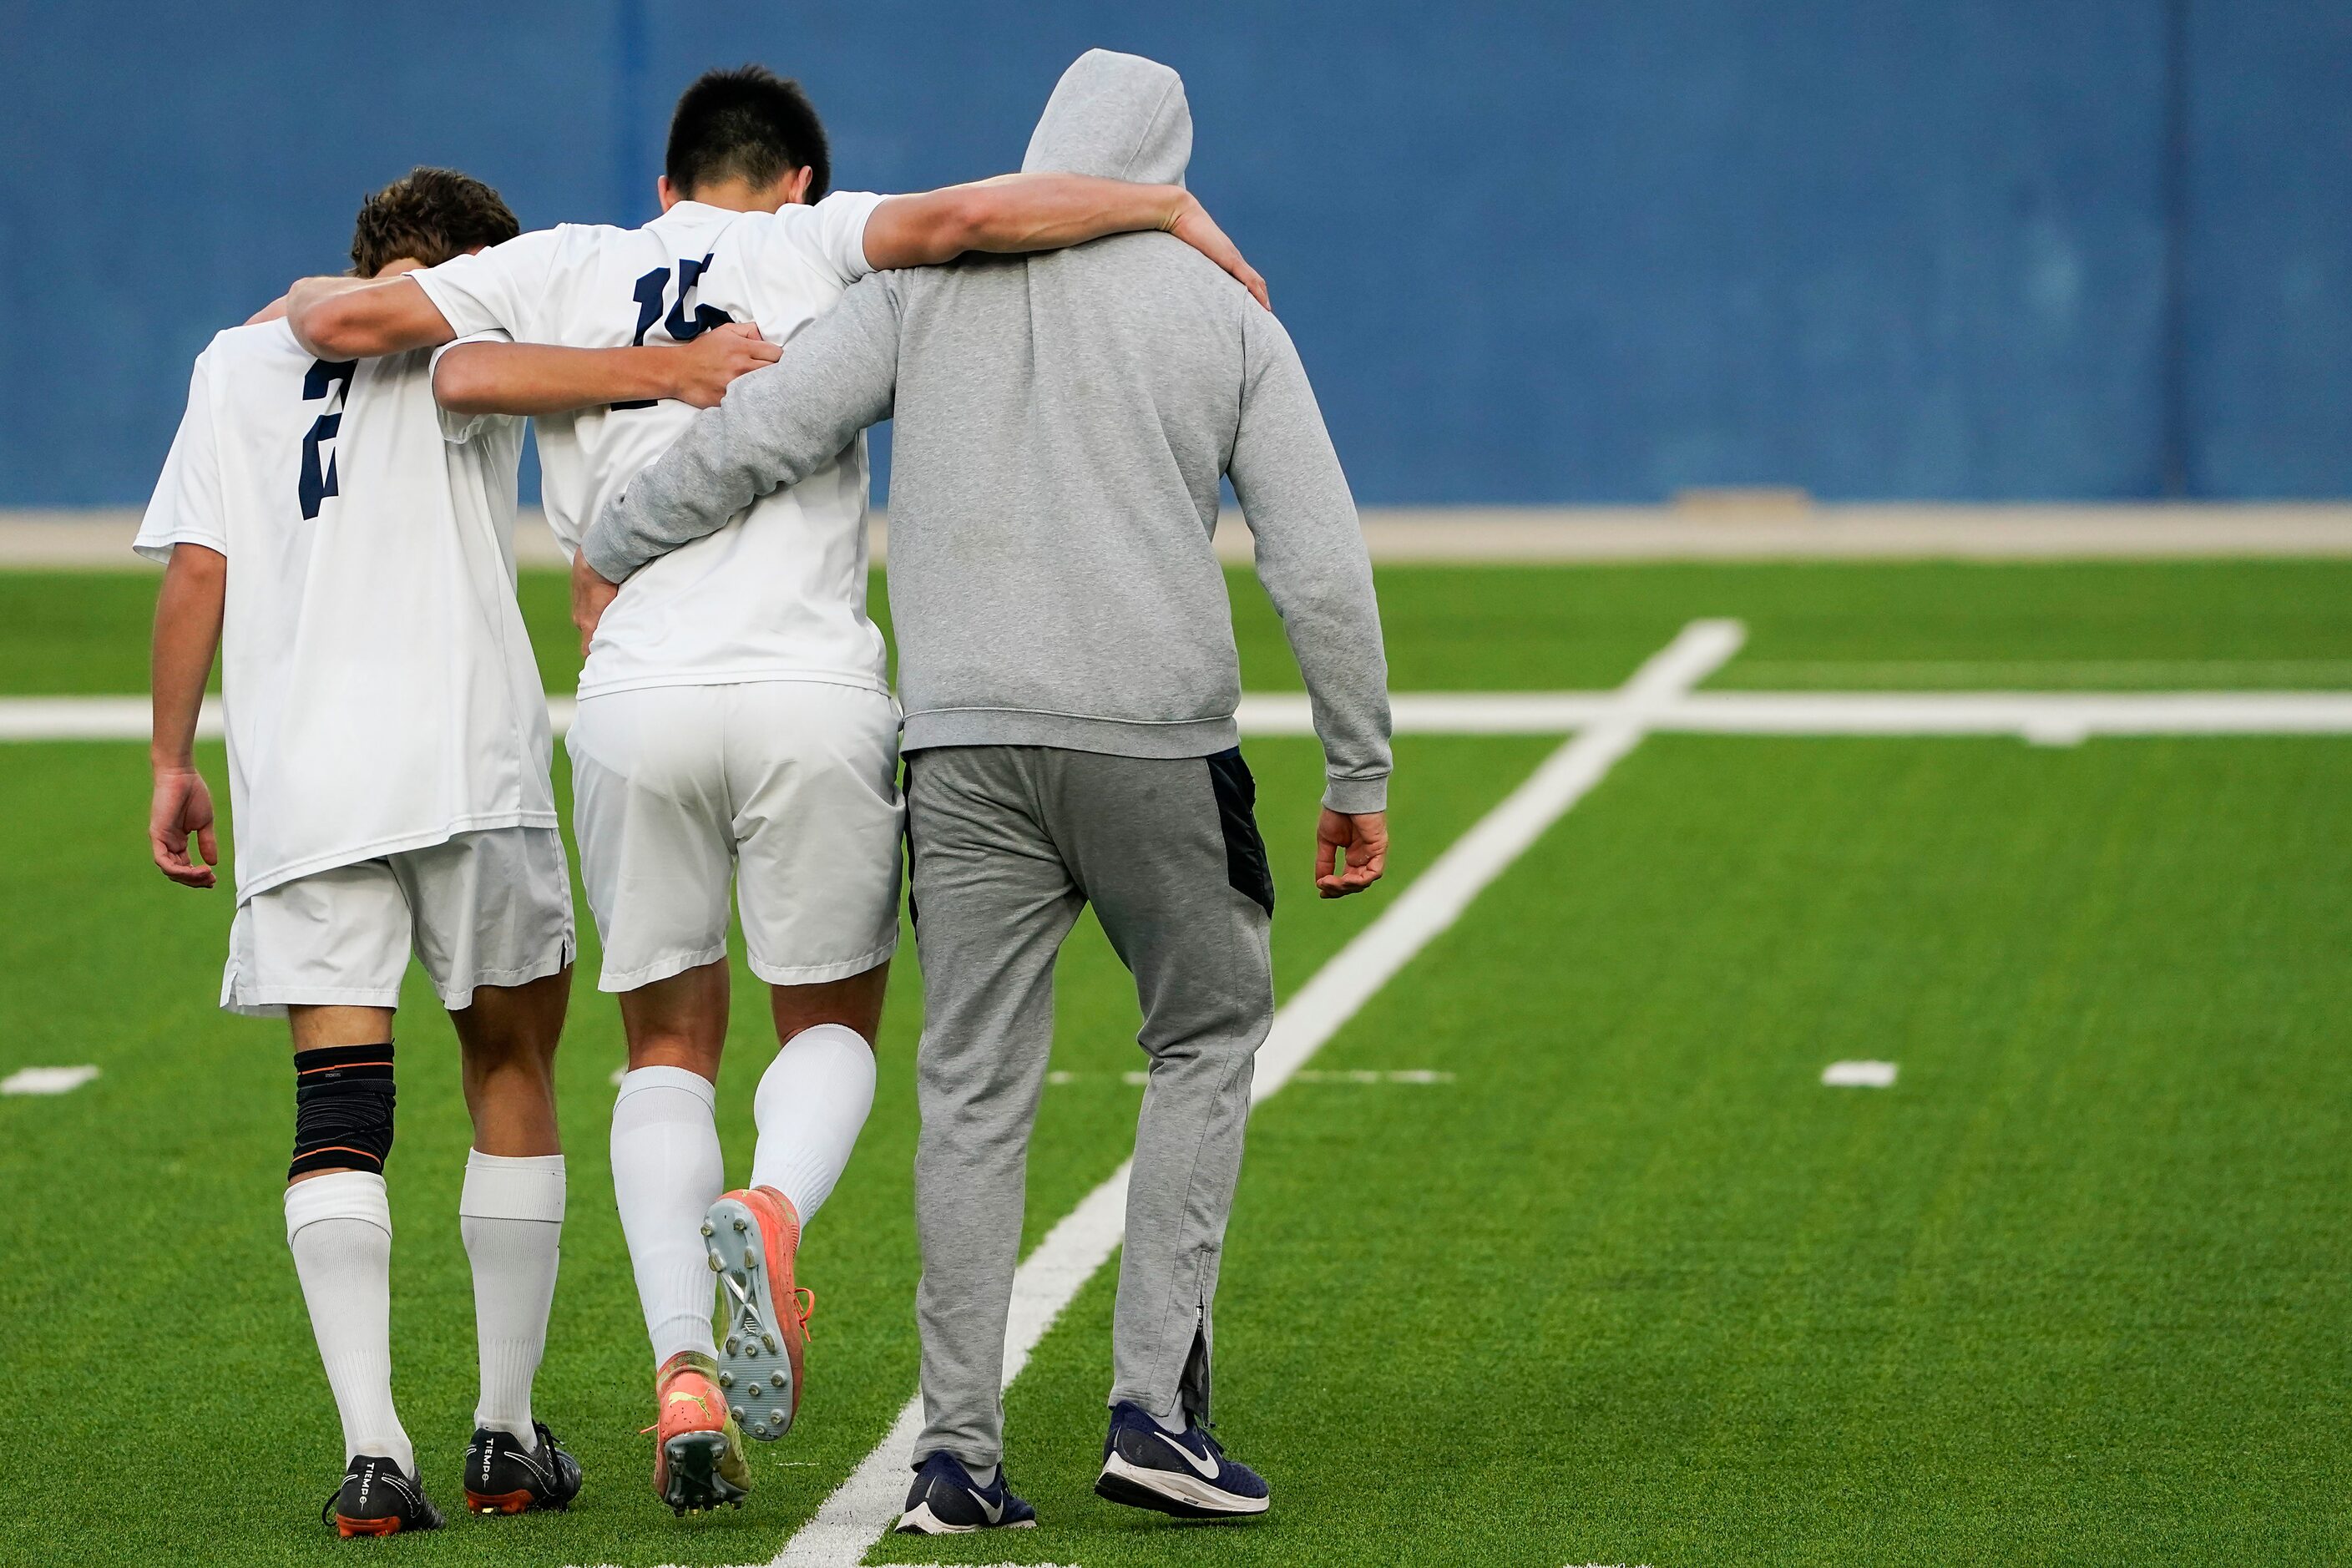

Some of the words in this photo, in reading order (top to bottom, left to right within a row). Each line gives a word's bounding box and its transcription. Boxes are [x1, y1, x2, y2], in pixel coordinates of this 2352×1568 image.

[298, 358, 359, 520] 2
[359, 1462, 375, 1510] TIEMPO
[482, 1438, 494, 1488] TIEMPO
